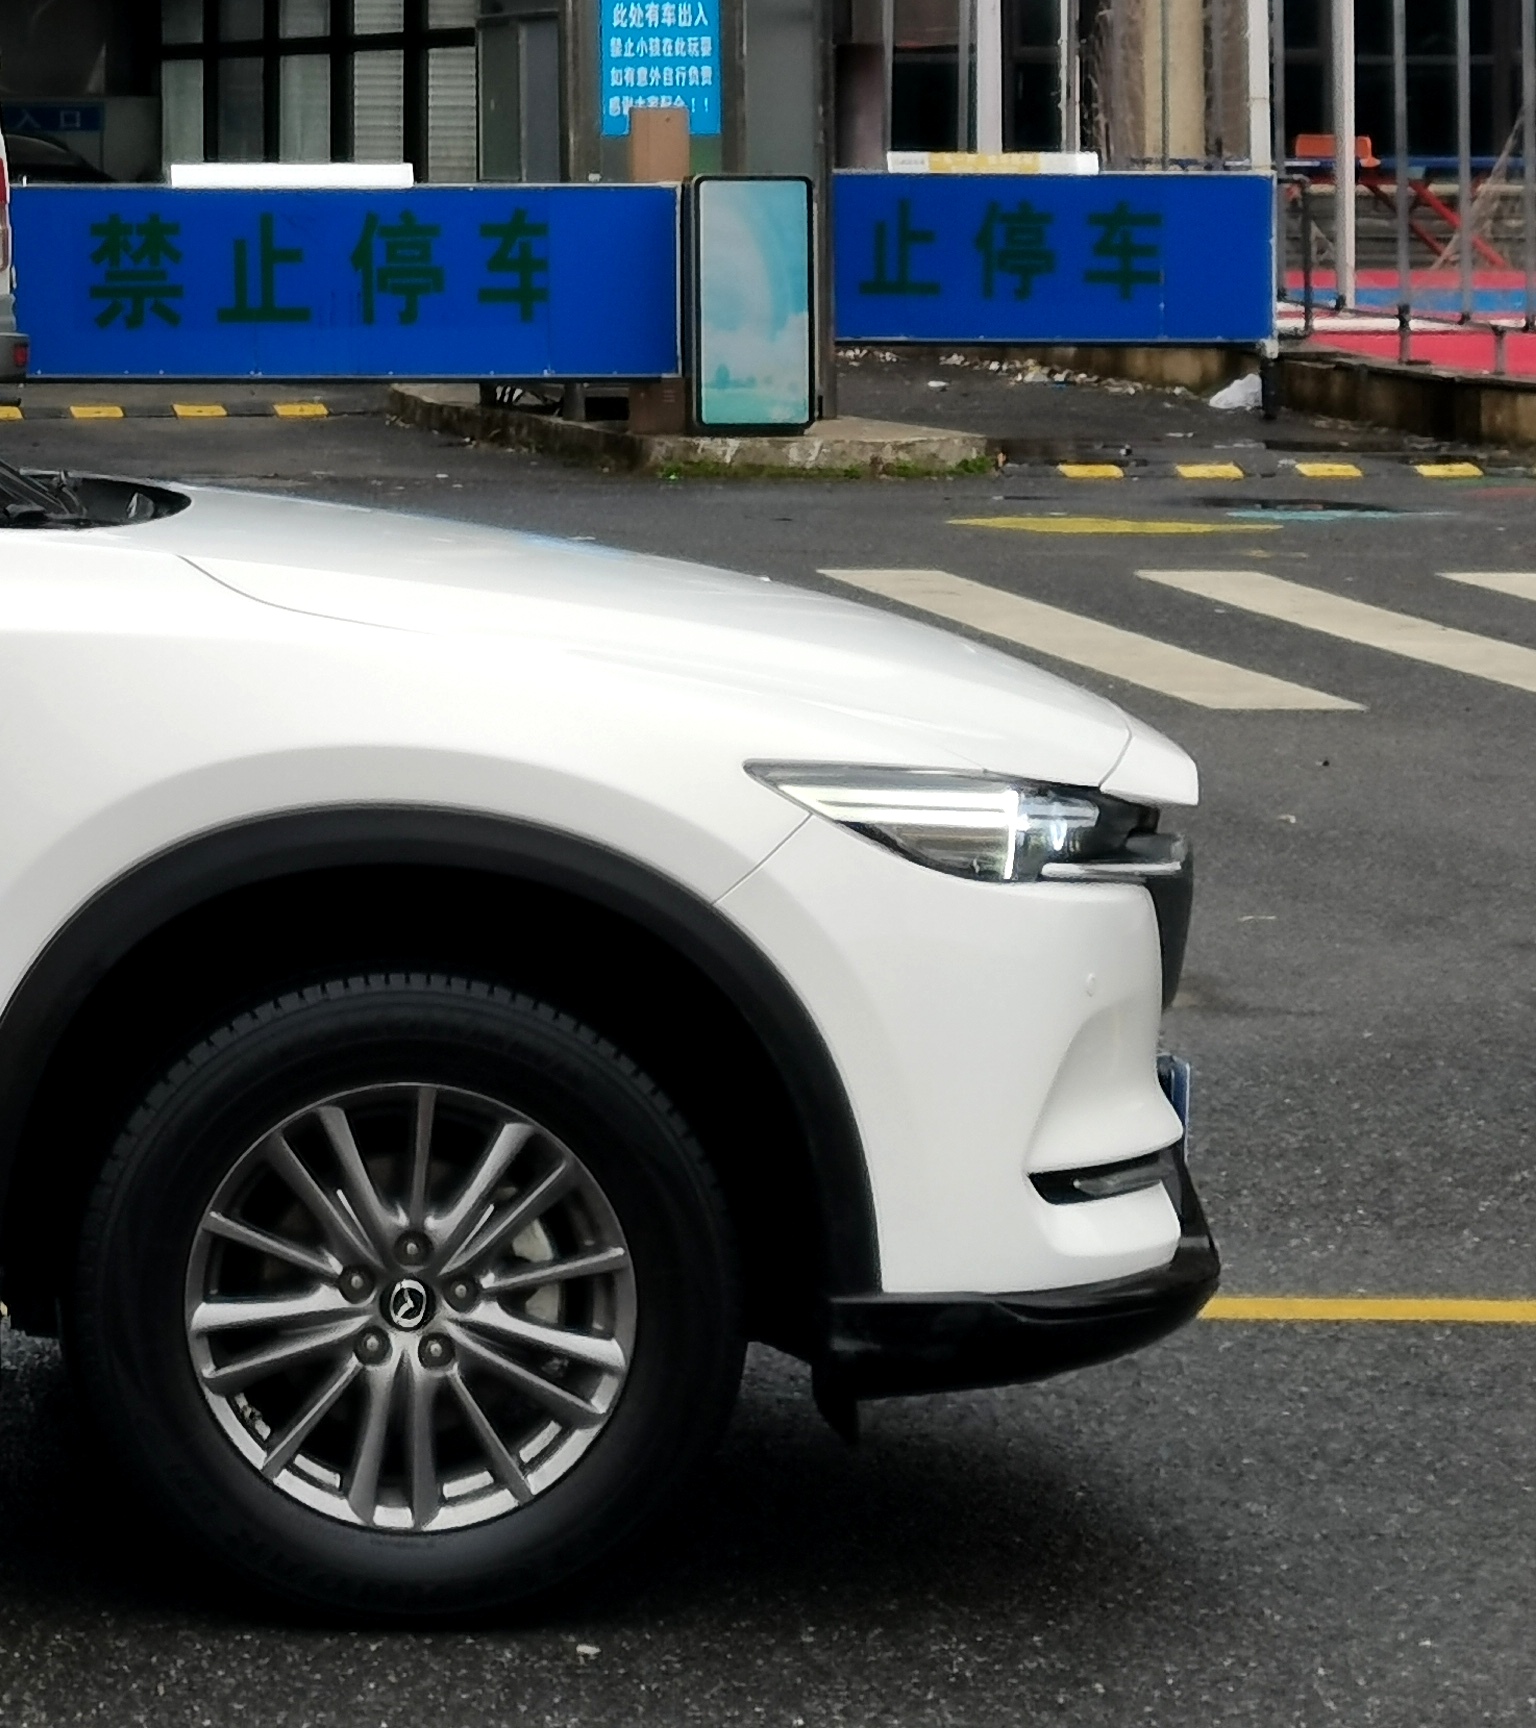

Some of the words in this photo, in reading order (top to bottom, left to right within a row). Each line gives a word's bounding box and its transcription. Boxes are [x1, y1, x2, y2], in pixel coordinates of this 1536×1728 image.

[612, 1, 709, 29] 此处有车出入
[14, 108, 81, 129] 入口
[89, 207, 548, 330] 禁止停车
[858, 198, 1163, 301] 止停车
